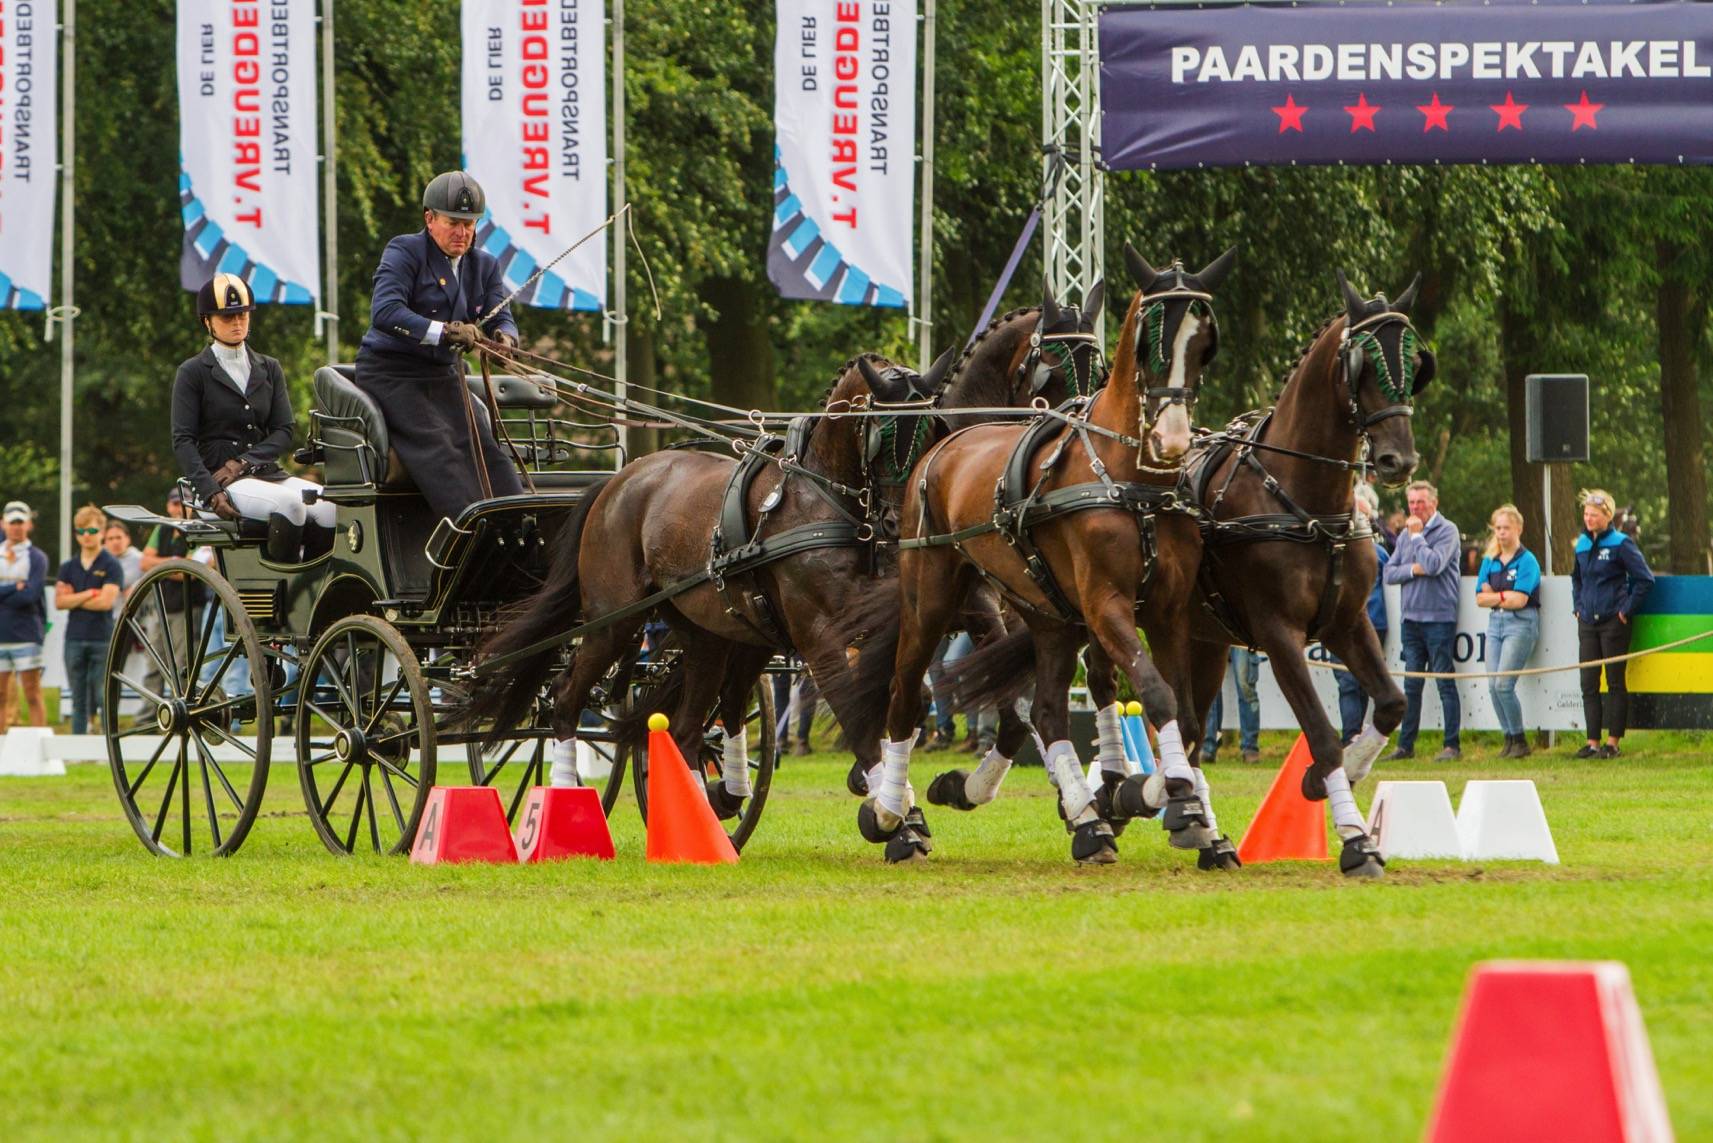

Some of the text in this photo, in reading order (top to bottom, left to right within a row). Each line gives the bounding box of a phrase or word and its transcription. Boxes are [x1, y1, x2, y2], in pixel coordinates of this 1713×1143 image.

[1171, 41, 1711, 83] PAARDENSPEKTAKEL
[419, 802, 438, 851] A
[521, 803, 540, 849] 5
[1369, 799, 1384, 847] A
